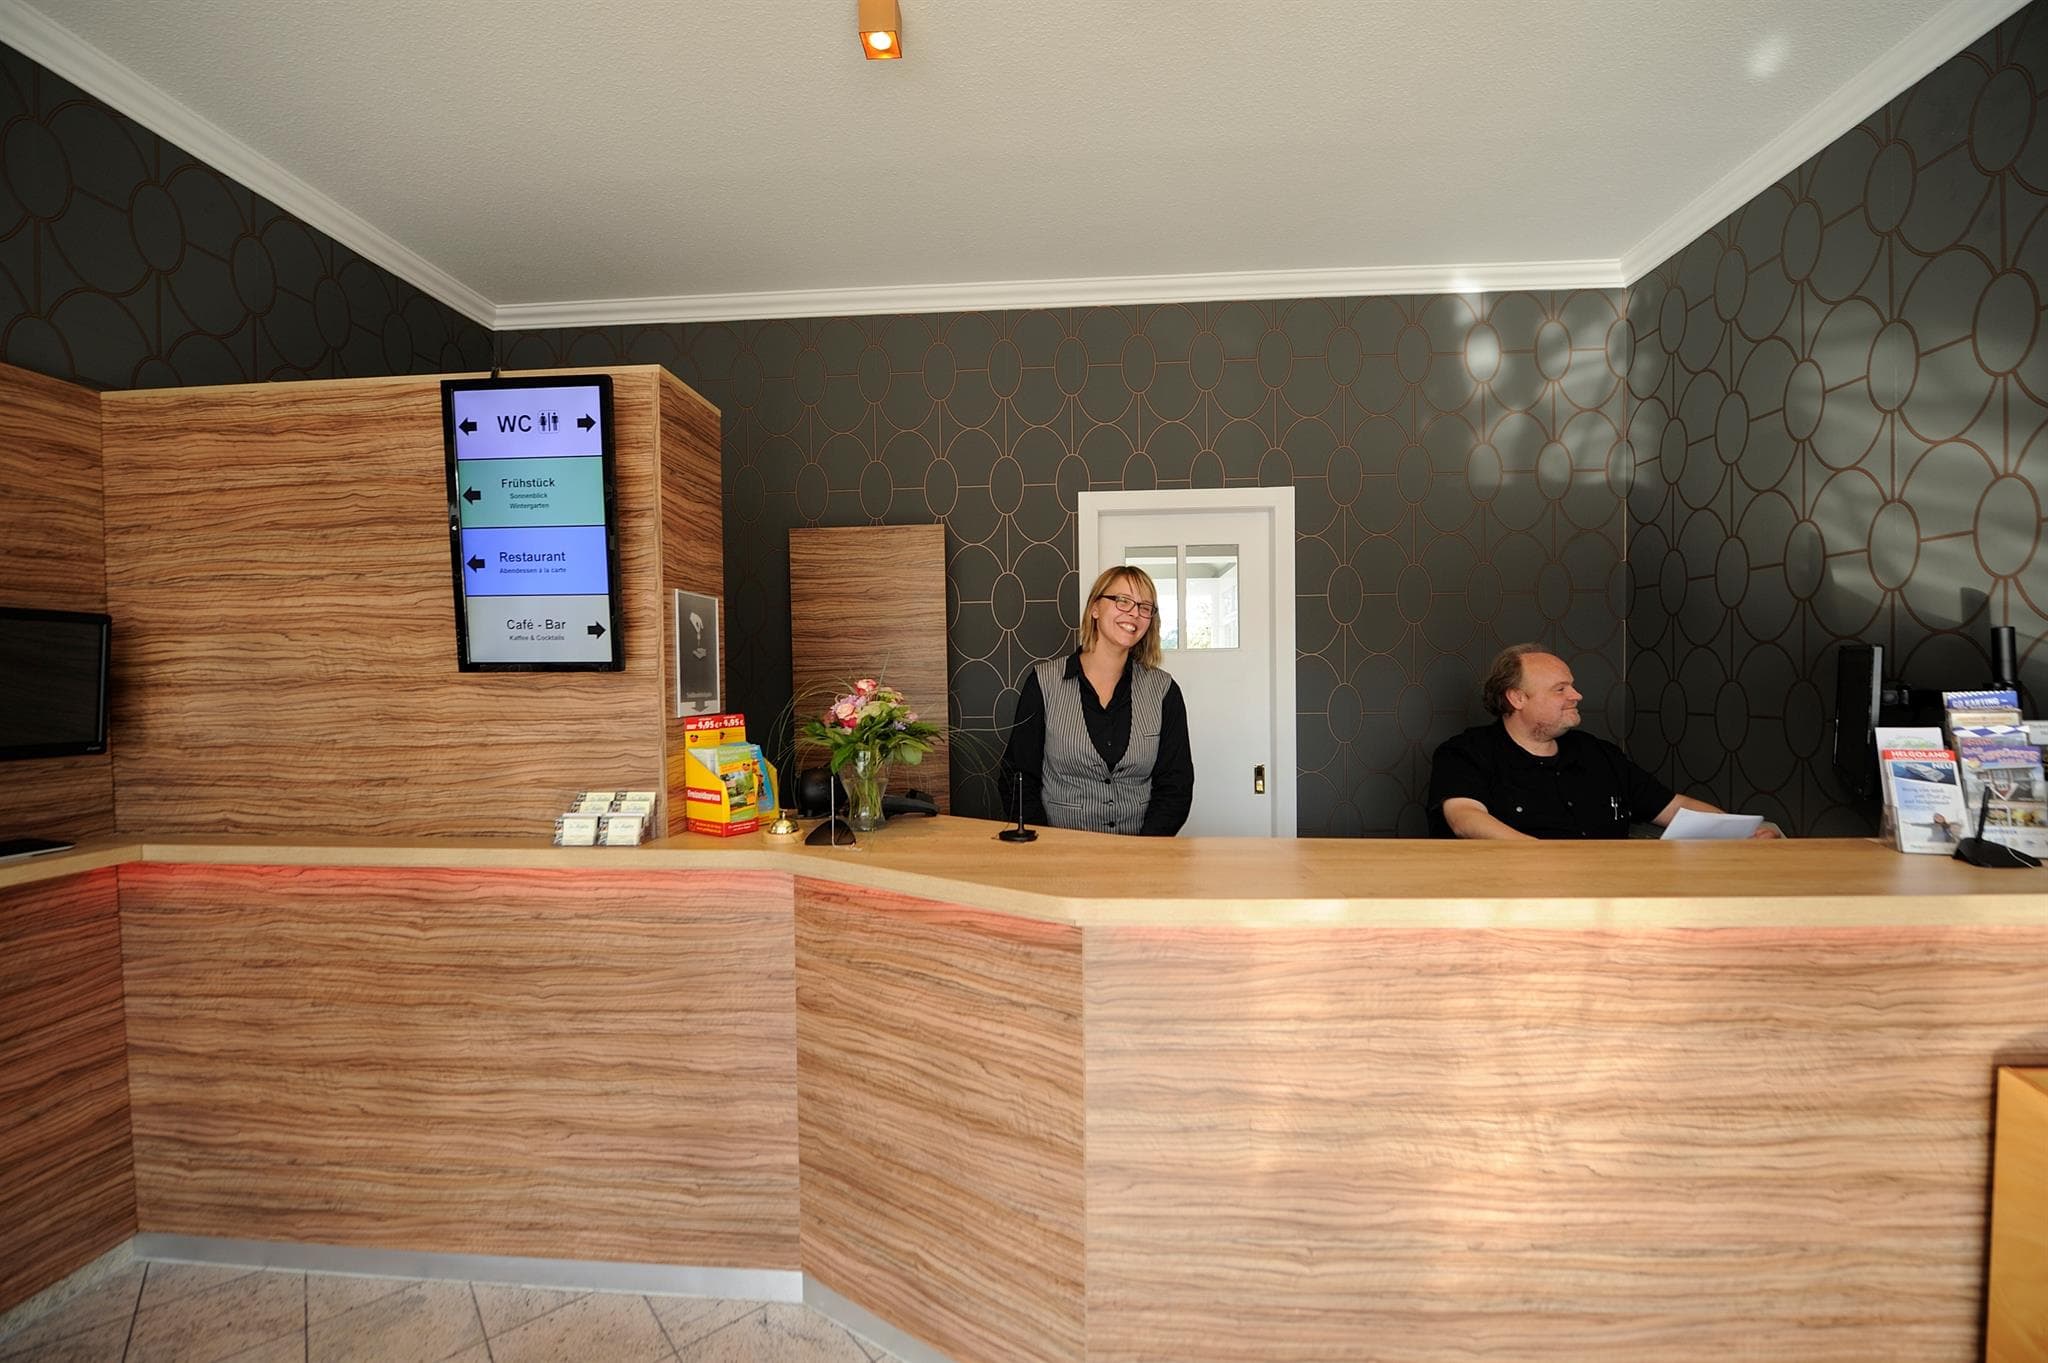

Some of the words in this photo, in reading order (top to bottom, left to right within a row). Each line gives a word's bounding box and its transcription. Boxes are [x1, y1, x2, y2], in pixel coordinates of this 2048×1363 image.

[497, 415, 532, 433] WC
[501, 477, 555, 489] Frühstück
[499, 551, 566, 563] Restaurant
[506, 618, 534, 630] Café
[545, 619, 567, 630] Bar
[1891, 750, 1950, 760] HELGOLAND
